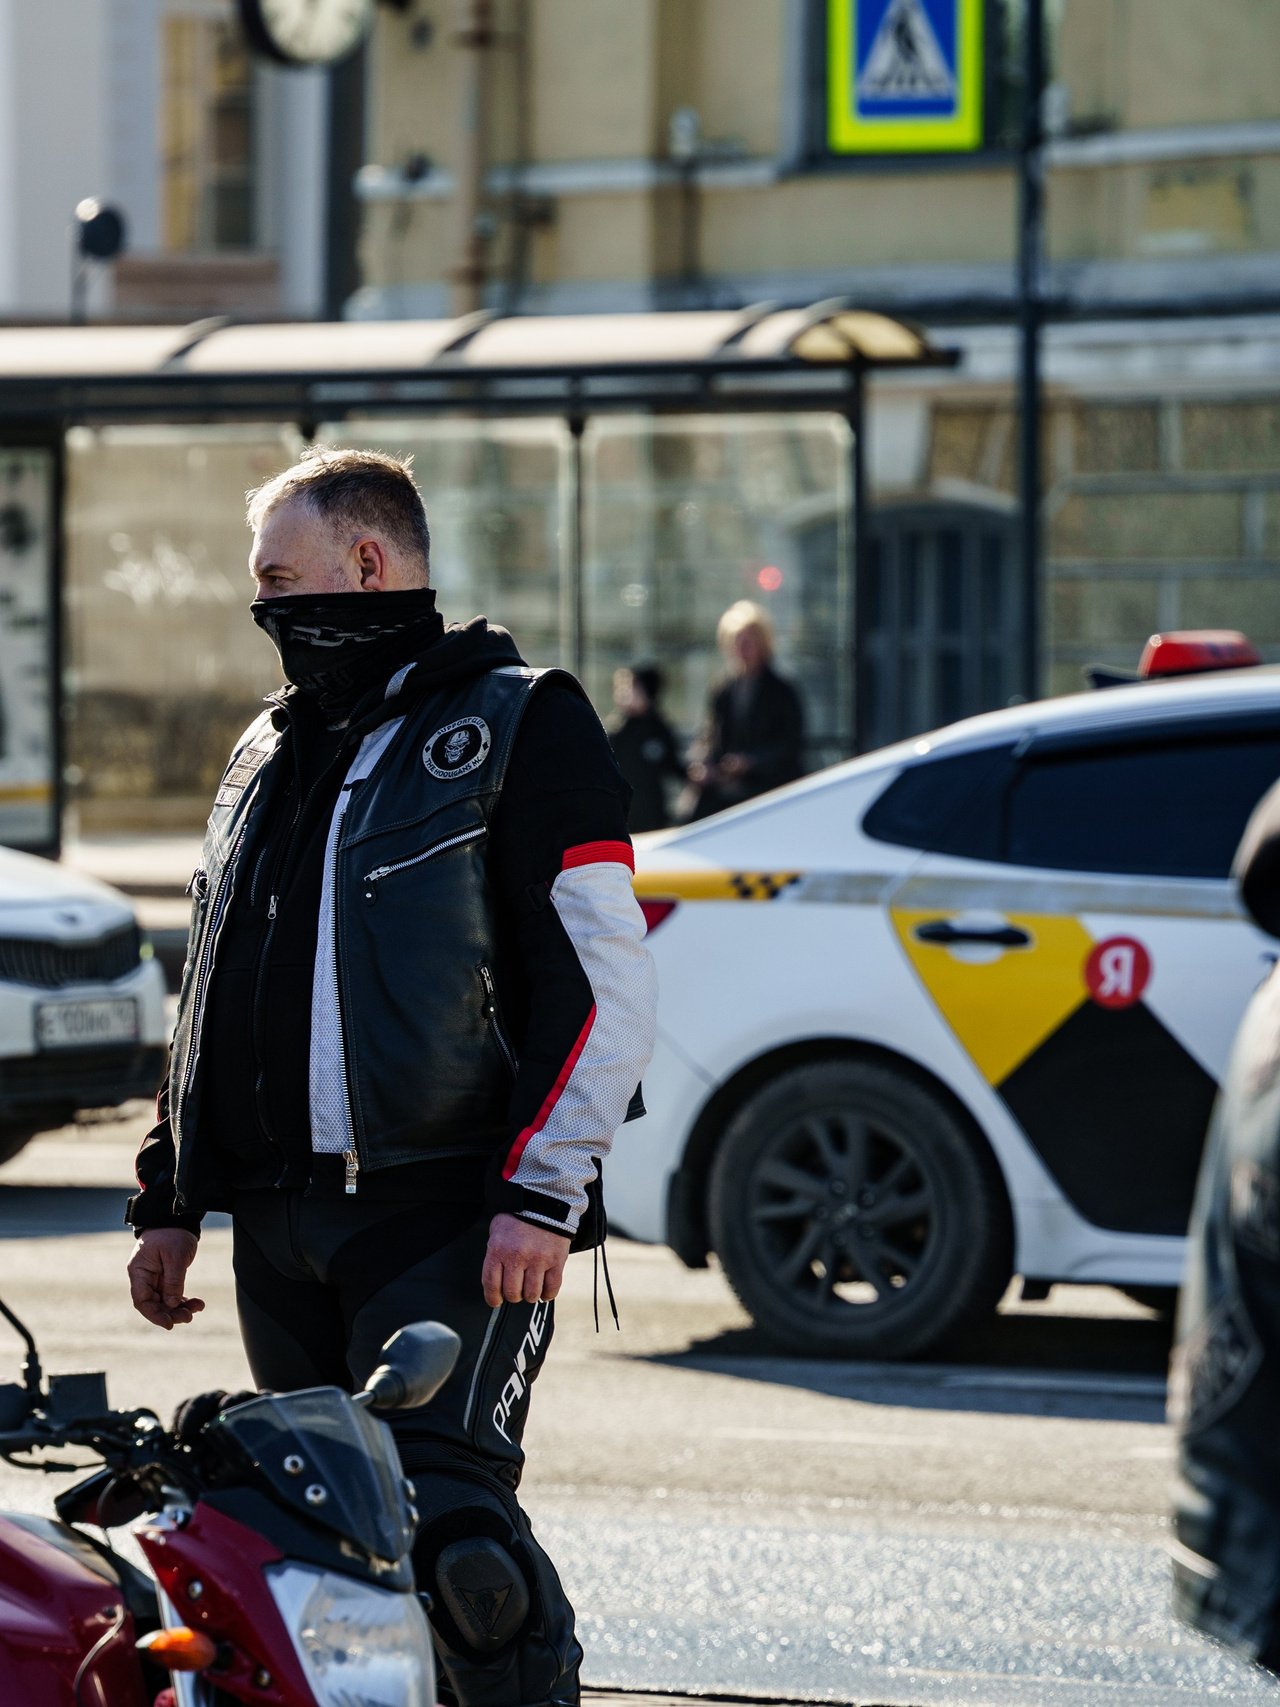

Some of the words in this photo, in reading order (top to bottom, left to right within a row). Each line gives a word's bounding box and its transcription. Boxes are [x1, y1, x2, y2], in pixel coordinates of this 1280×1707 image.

[436, 717, 473, 736] SUPPORT
[472, 717, 486, 729] CLUB
[425, 757, 436, 771] THE
[434, 763, 472, 778] HOOLIGANS
